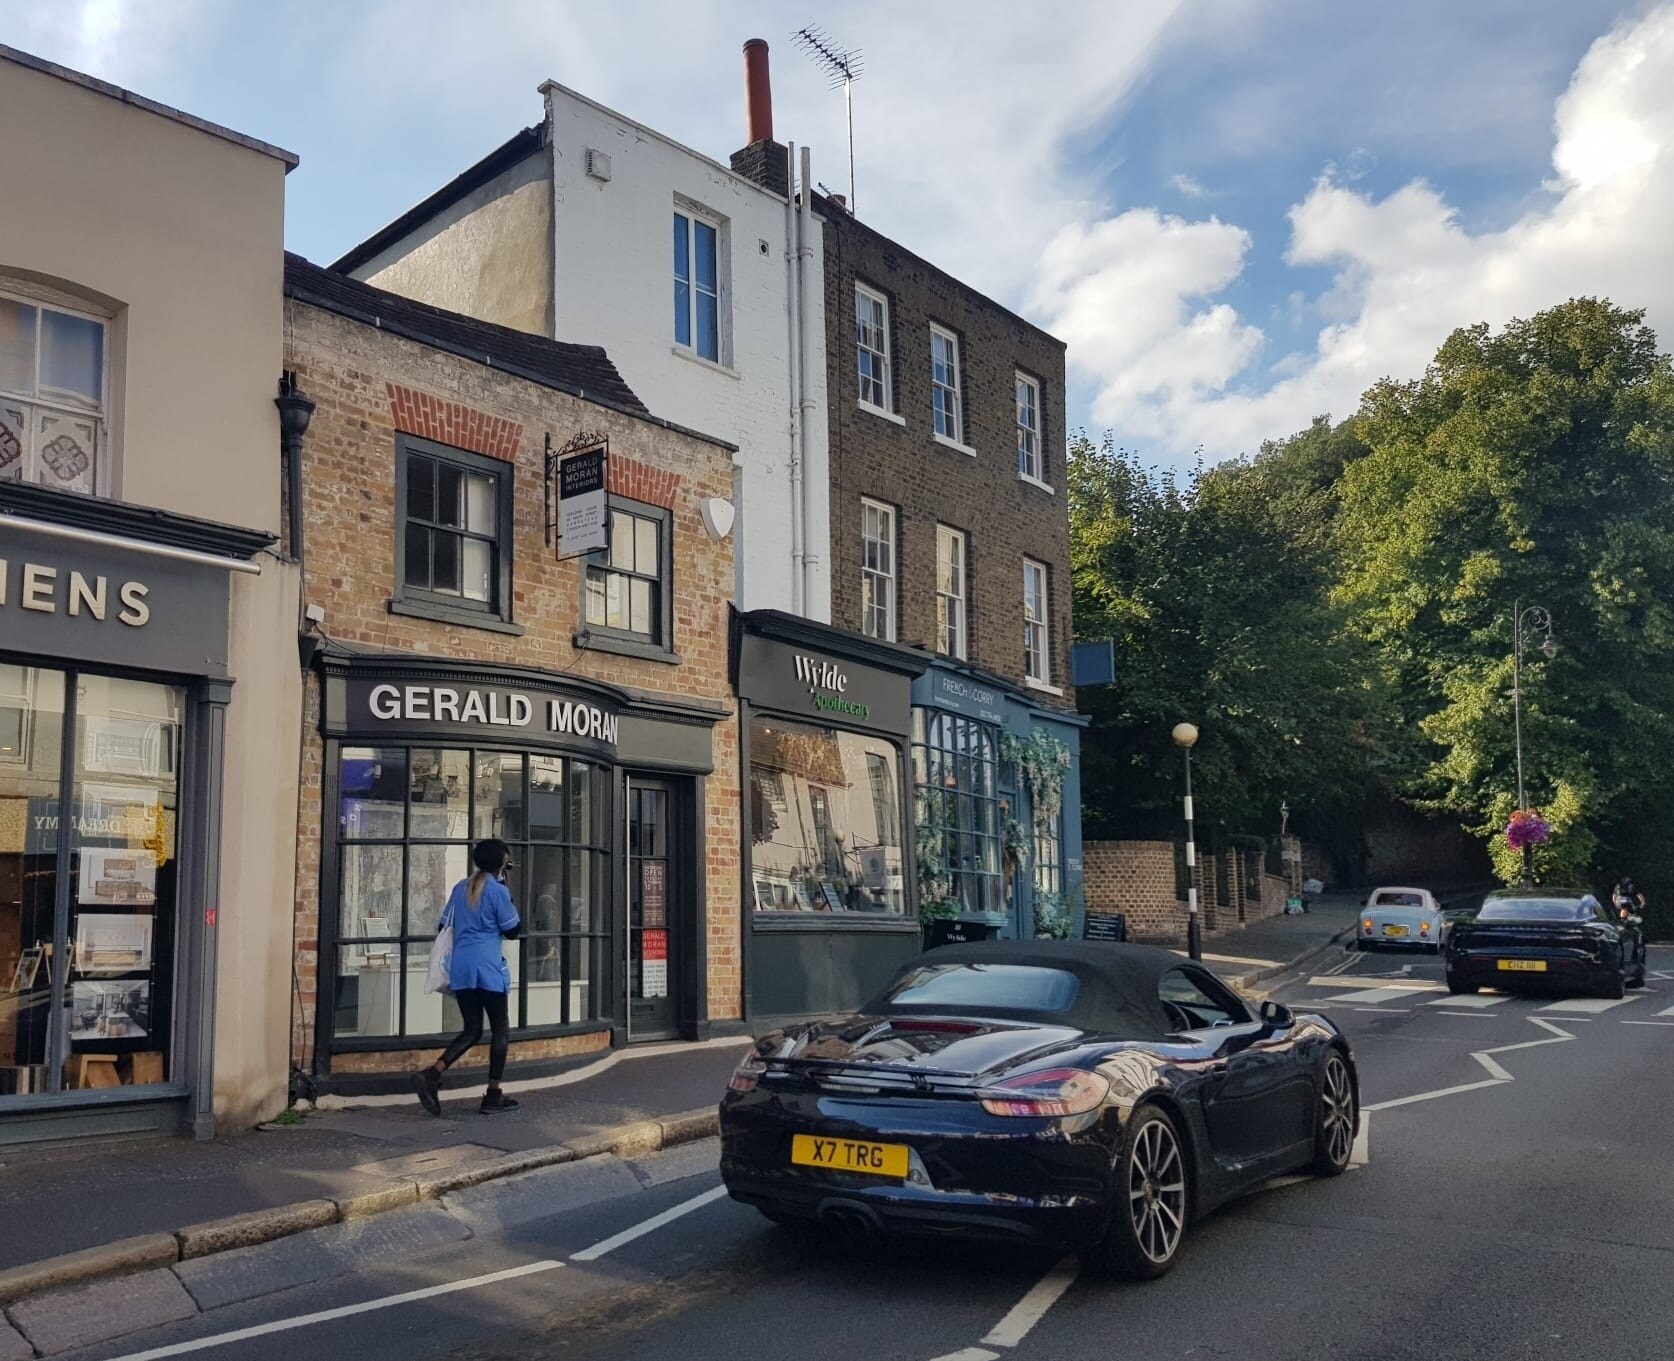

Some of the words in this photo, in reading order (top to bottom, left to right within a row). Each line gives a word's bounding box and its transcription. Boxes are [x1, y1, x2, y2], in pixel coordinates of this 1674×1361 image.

[566, 457, 598, 473] GERALD
[566, 466, 598, 484] MORAN
[0, 559, 150, 626] ENS
[795, 655, 847, 693] Wylde
[369, 685, 533, 726] GERALD
[551, 700, 618, 745] MORAN
[814, 692, 870, 720] Apothecary
[813, 1139, 837, 1162] X7
[844, 1144, 883, 1167] TRG
